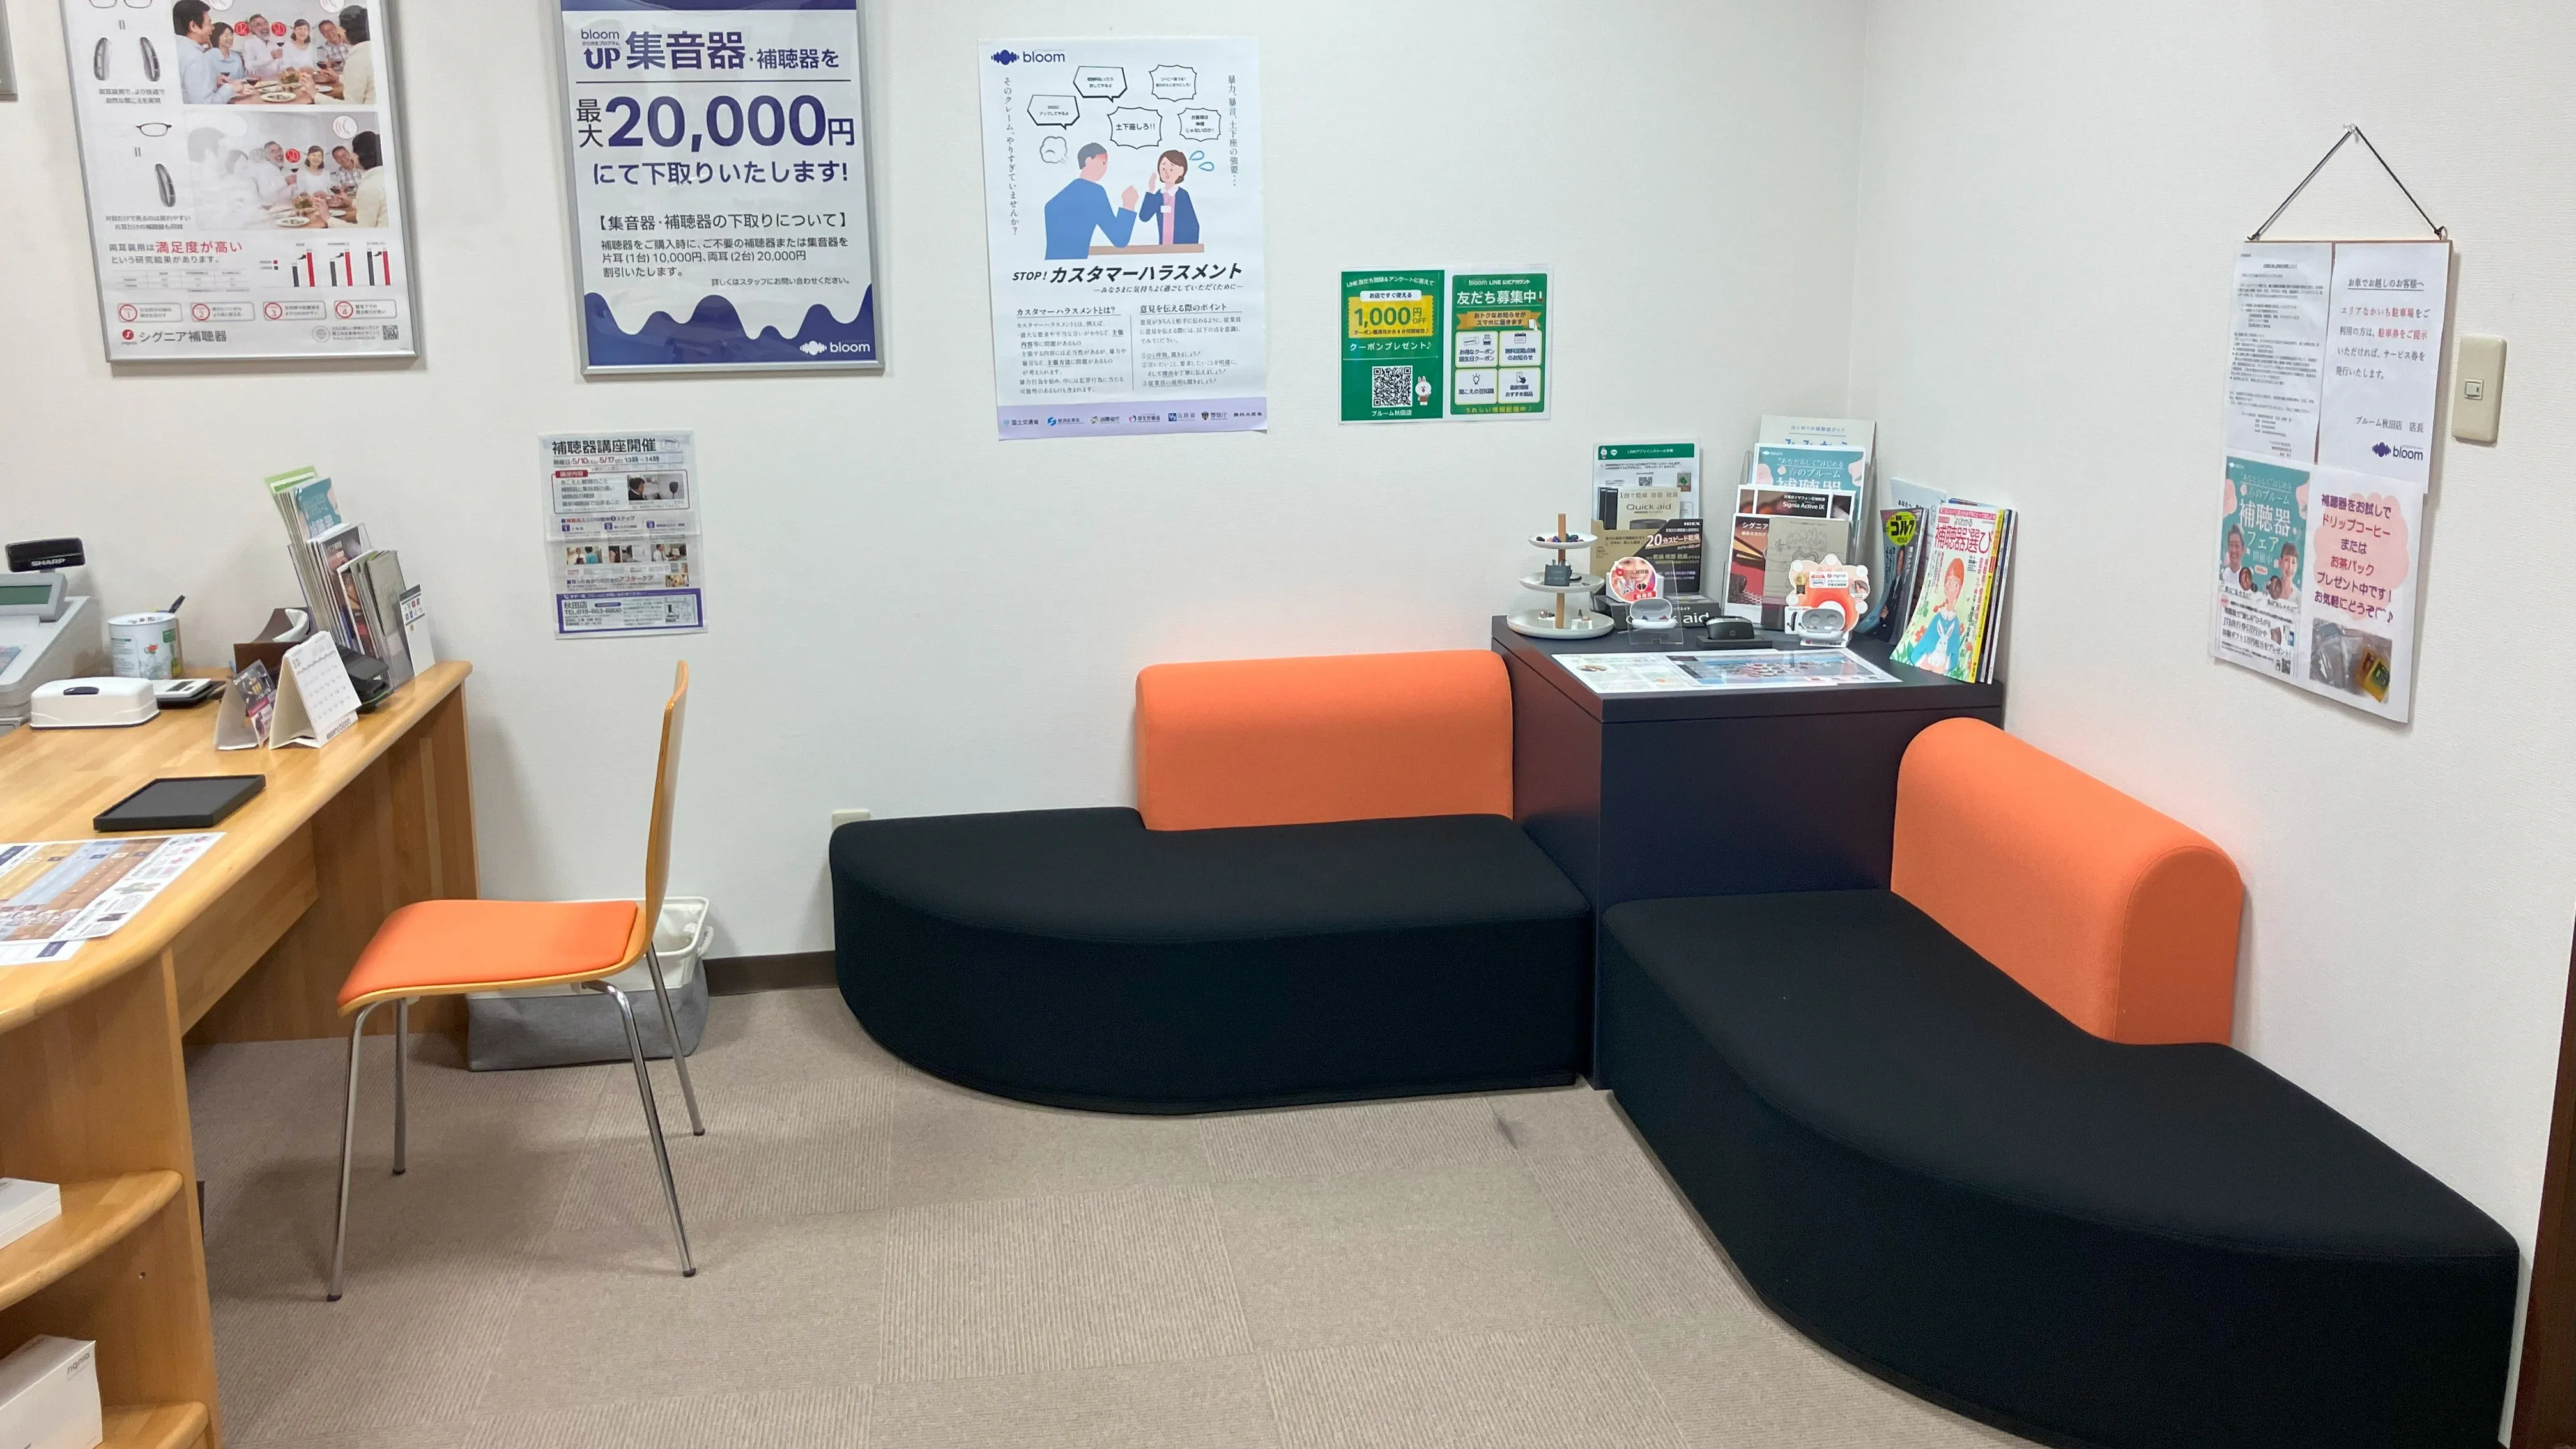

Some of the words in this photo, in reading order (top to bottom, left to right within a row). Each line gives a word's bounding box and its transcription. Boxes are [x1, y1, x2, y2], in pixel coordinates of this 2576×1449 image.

[581, 29, 620, 40] bloom
[583, 48, 621, 70] UP
[1023, 51, 1065, 63] bloom
[576, 99, 603, 148] 最大
[593, 160, 848, 185] にて下取りいたします!
[109, 241, 243, 254] 両耳装用は満足度が高い
[601, 237, 848, 252] 補聴器をご購入時に、ご不要の補聴器または集音器を
[111, 256, 220, 264] という研究結果があります。
[603, 266, 684, 279] 割引いたします。
[1013, 271, 1048, 282] STOP!
[1050, 263, 1243, 284] カスタマーハラスメント
[711, 277, 850, 286] 詳しくはスタッフにお問い合わせください。
[2348, 278, 2425, 288] お車でお越しのお客様へ
[1457, 289, 1543, 305] 友だち募集中!
[1016, 307, 1116, 316] カスタマーハラスメントとは?
[1140, 303, 1227, 313] 意見を伝える際のポイント
[2341, 307, 2430, 318] エリアなかいち駐車場をご
[1354, 307, 1411, 328] 1,000
[139, 330, 227, 342] シグニア補聴器
[830, 341, 870, 354] bloom
[2337, 346, 2425, 362] いただければ、サービス券を
[2336, 366, 2384, 379] 発行いたします。
[2355, 415, 2402, 431] ブルーム秋田店
[2409, 422, 2424, 433] 店長
[552, 438, 657, 455] 補聴器講座開催
[2393, 447, 2423, 461] bloom
[2321, 493, 2391, 519] 補聴器をお試しで
[2239, 498, 2291, 537] 補聴器
[2322, 513, 2391, 538] ドリップコーヒー
[1935, 524, 1992, 554] 補聴器選び
[2247, 532, 2279, 553] フェア
[2341, 538, 2367, 555] または
[31, 558, 65, 567] SHARP
[2330, 556, 2375, 576] お茶パック
